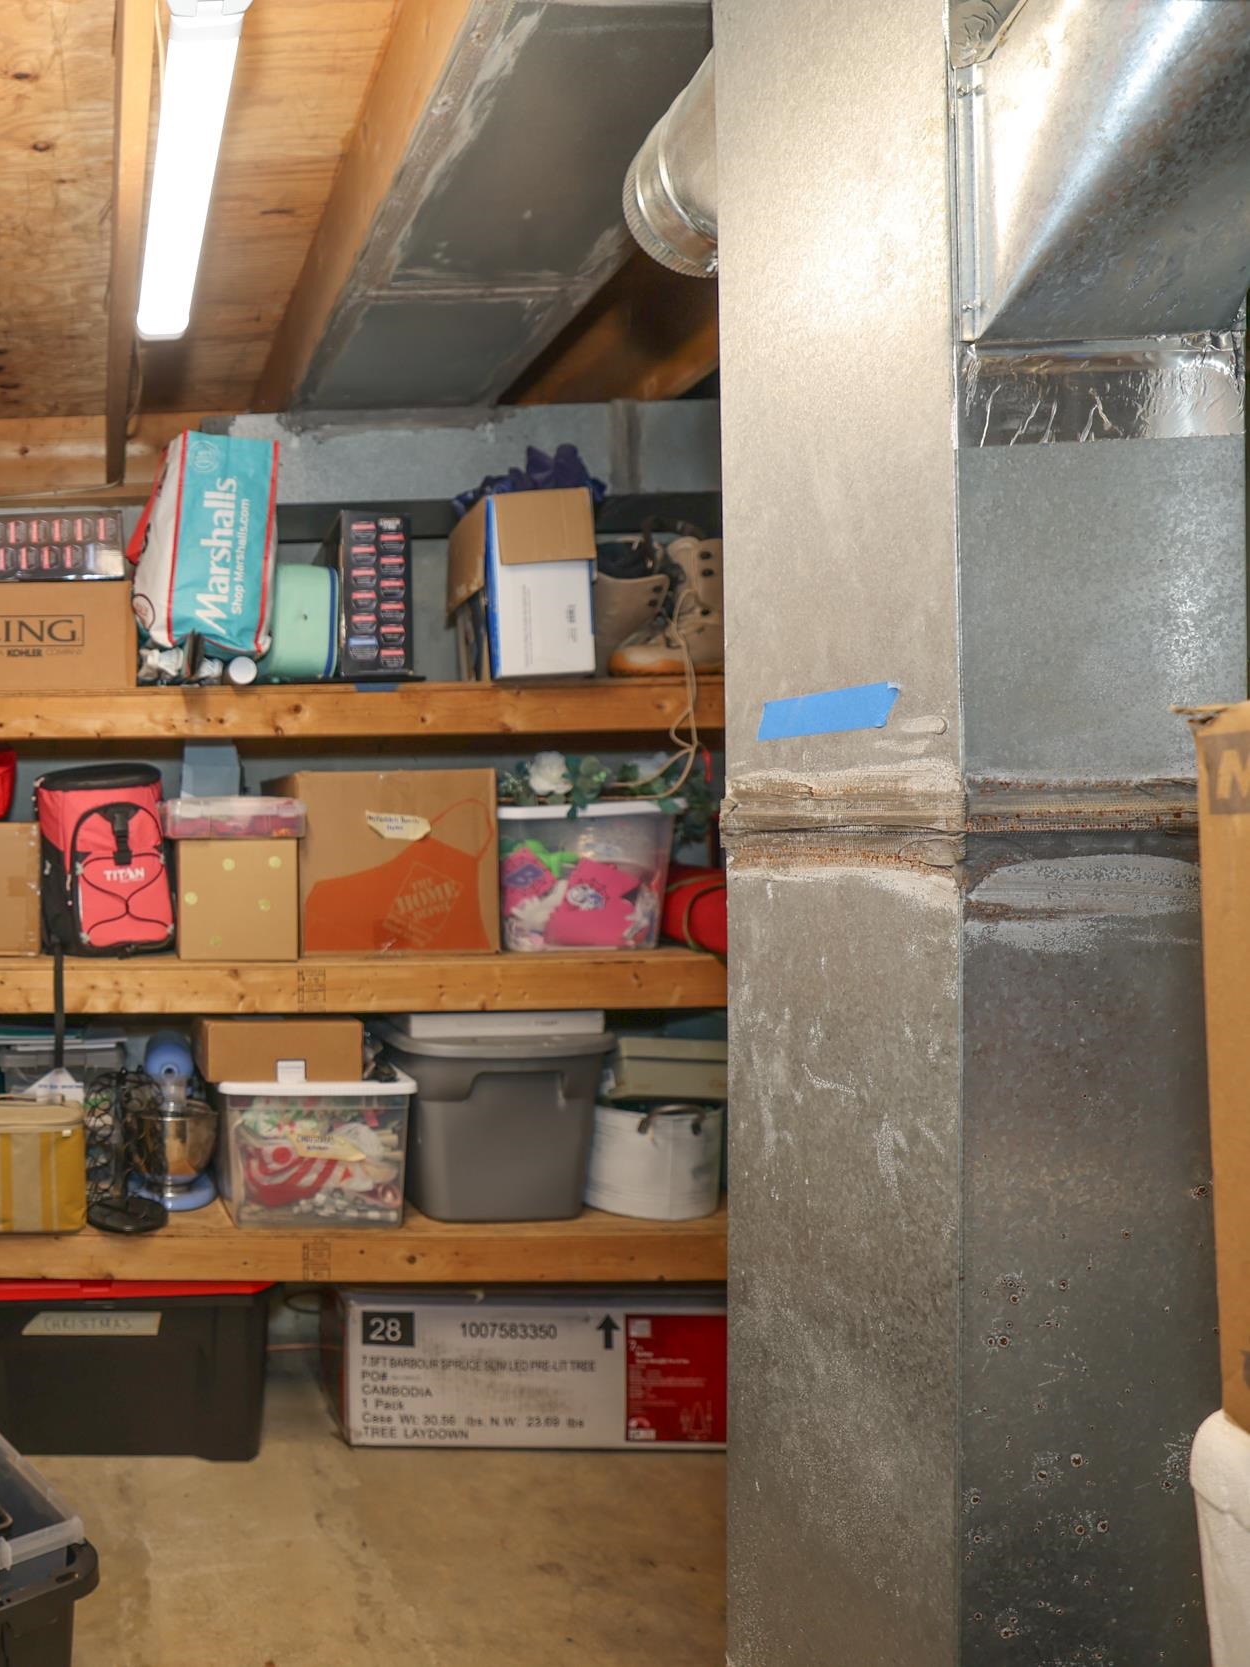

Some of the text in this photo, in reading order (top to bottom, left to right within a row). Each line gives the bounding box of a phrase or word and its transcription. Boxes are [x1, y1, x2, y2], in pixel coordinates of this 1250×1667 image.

[194, 476, 239, 635] Marshalls
[231, 498, 250, 615] Shop Marshalls.com
[6, 648, 43, 657] KOHLER
[103, 867, 145, 881] TITAN
[44, 1317, 133, 1331] CHRISTMAS
[369, 1317, 402, 1341] 28
[441, 1359, 482, 1371] SPRUCE
[569, 1361, 596, 1373] TREE
[361, 1371, 387, 1382] PO#
[361, 1384, 433, 1397] CAMBODIA
[374, 1400, 405, 1410] Pack
[362, 1414, 393, 1425] Case
[363, 1427, 469, 1440] TREE LAYDOWN
